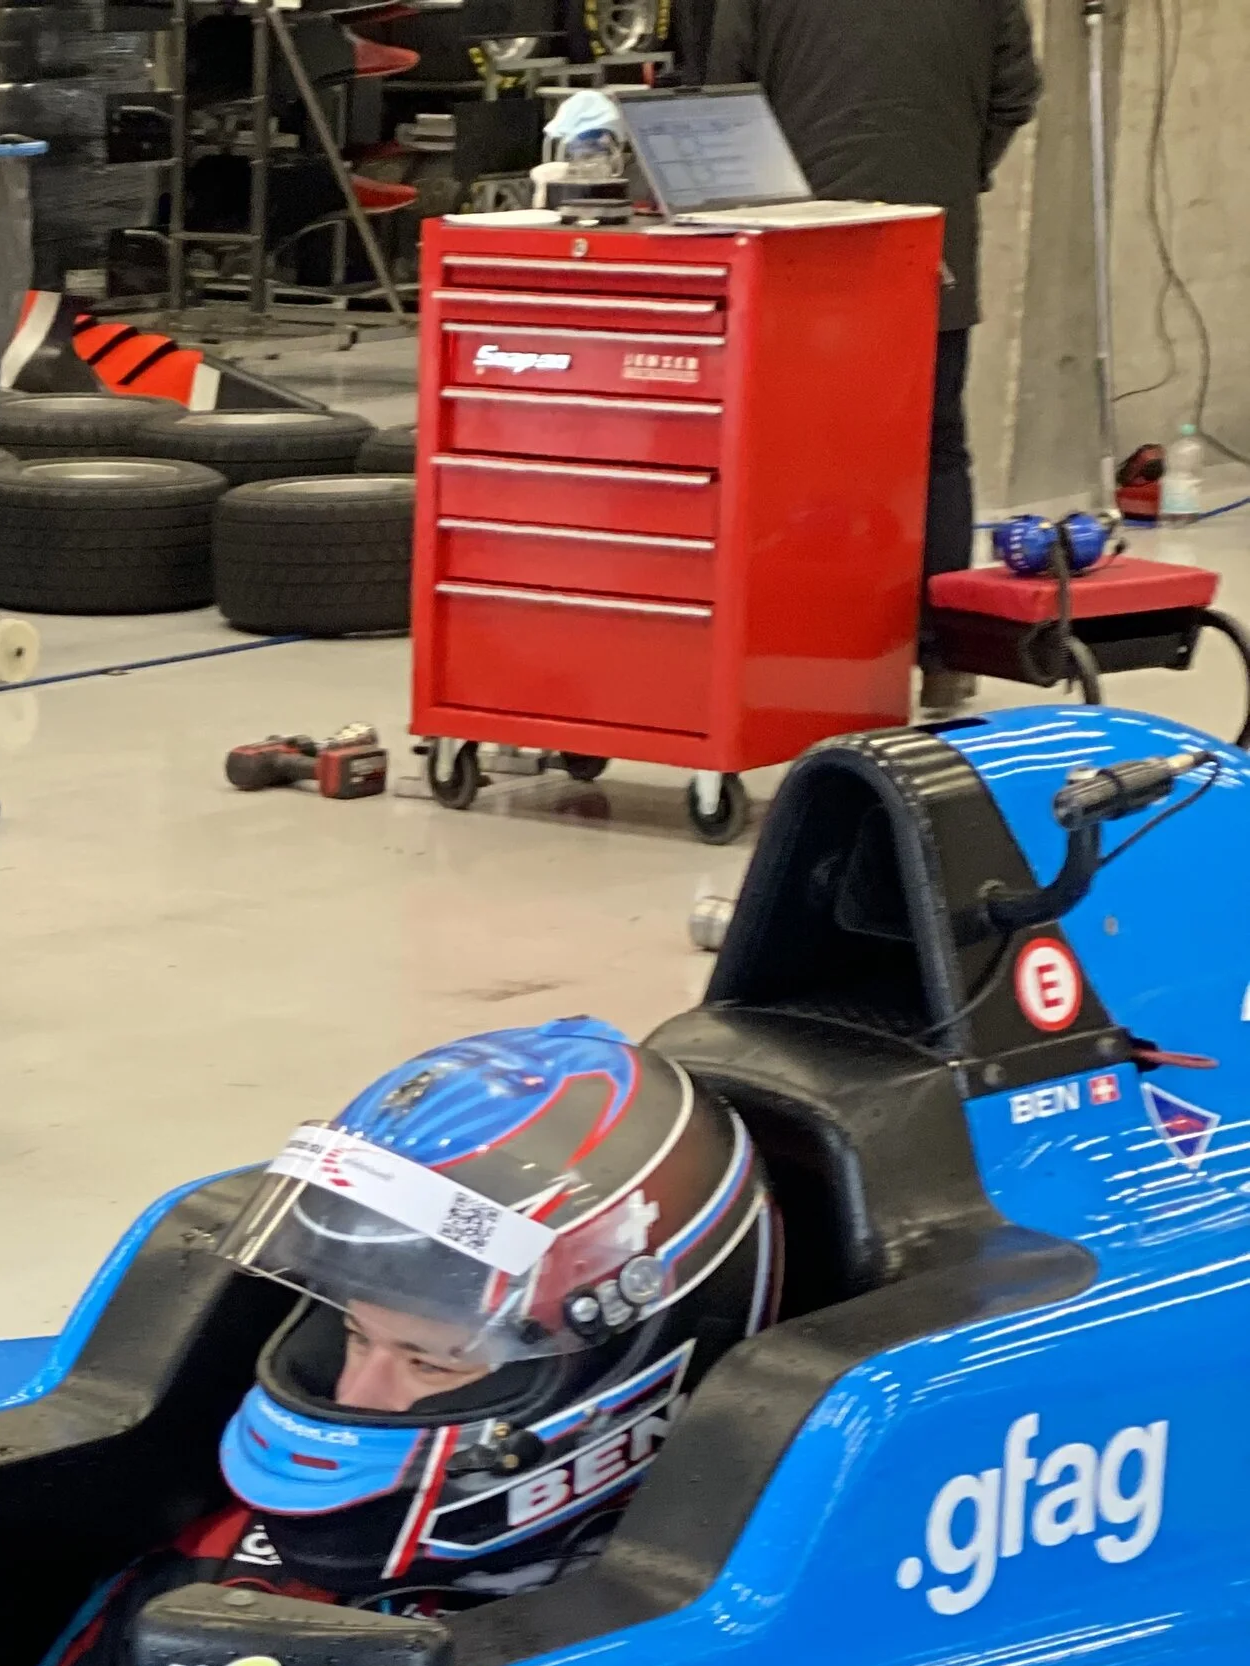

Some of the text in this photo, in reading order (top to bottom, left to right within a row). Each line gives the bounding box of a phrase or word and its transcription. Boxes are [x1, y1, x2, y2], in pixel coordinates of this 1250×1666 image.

[1036, 963, 1064, 1009] E
[1009, 1082, 1080, 1124] BEN
[507, 1393, 690, 1527] BEN
[896, 1412, 1169, 1615] .gfag
